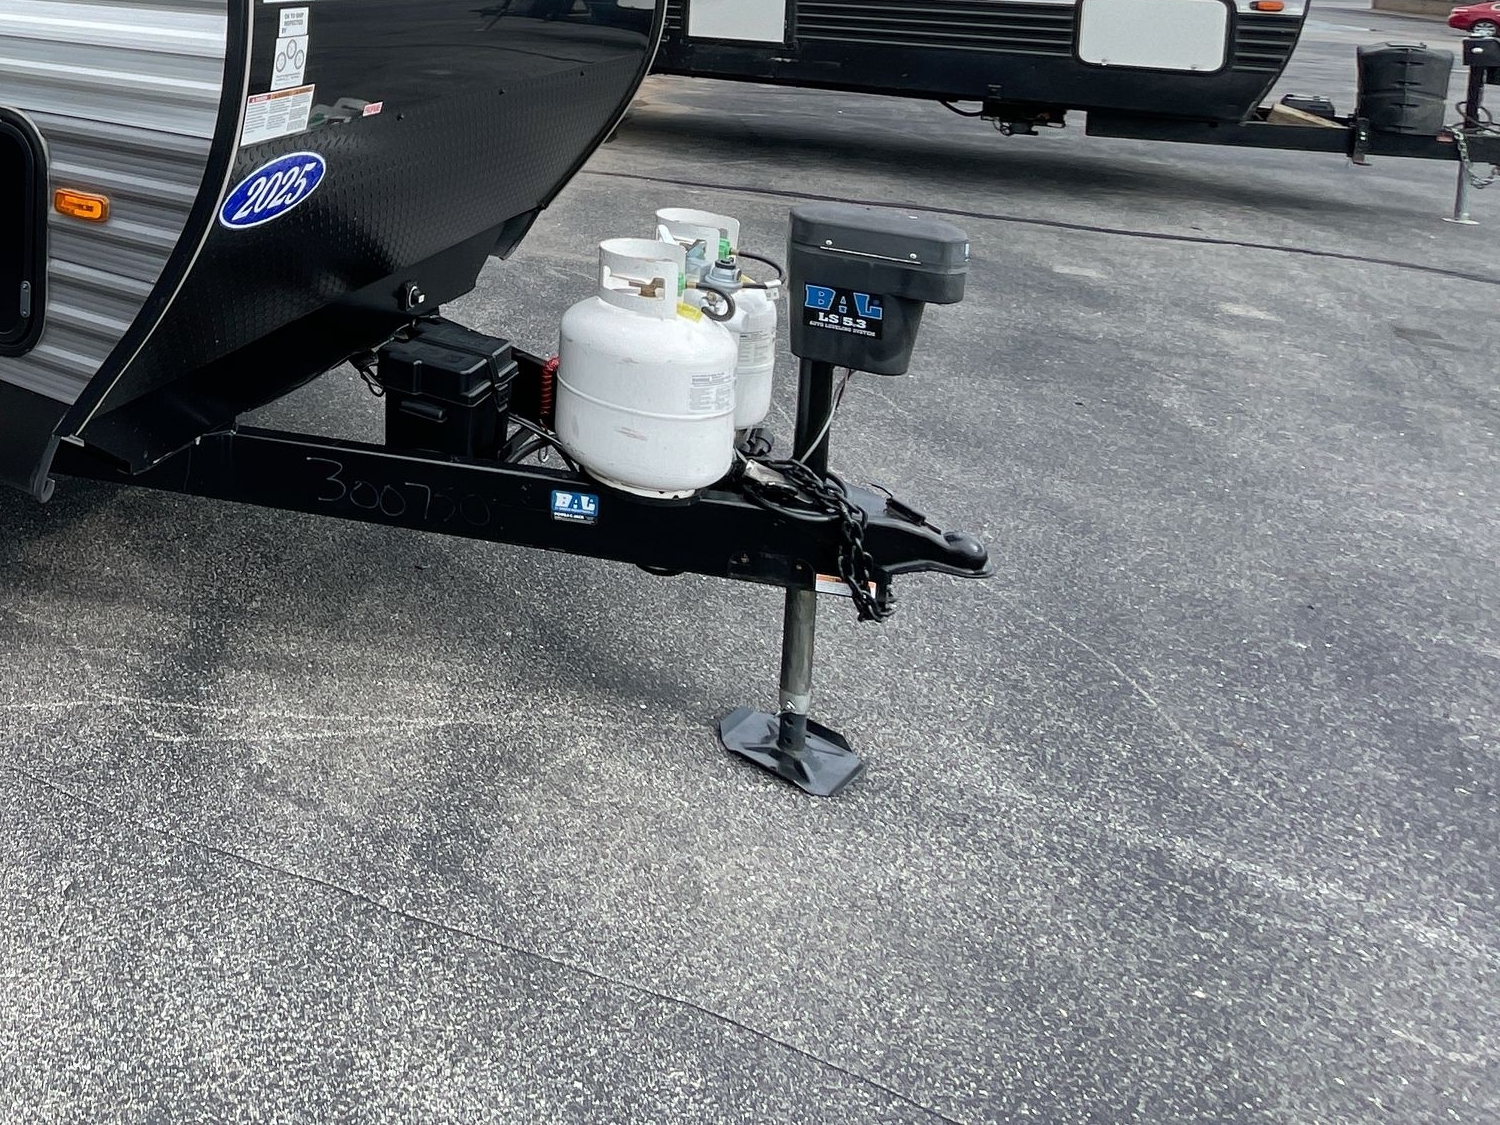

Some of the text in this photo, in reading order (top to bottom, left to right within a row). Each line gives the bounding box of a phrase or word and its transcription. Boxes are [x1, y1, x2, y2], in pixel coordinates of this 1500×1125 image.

[232, 163, 316, 221] 2025
[804, 284, 883, 320] BAL
[809, 320, 824, 328] AUTO
[852, 328, 876, 337] SYSTEM
[818, 312, 867, 329] LS 5.3
[555, 492, 596, 511] BAL
